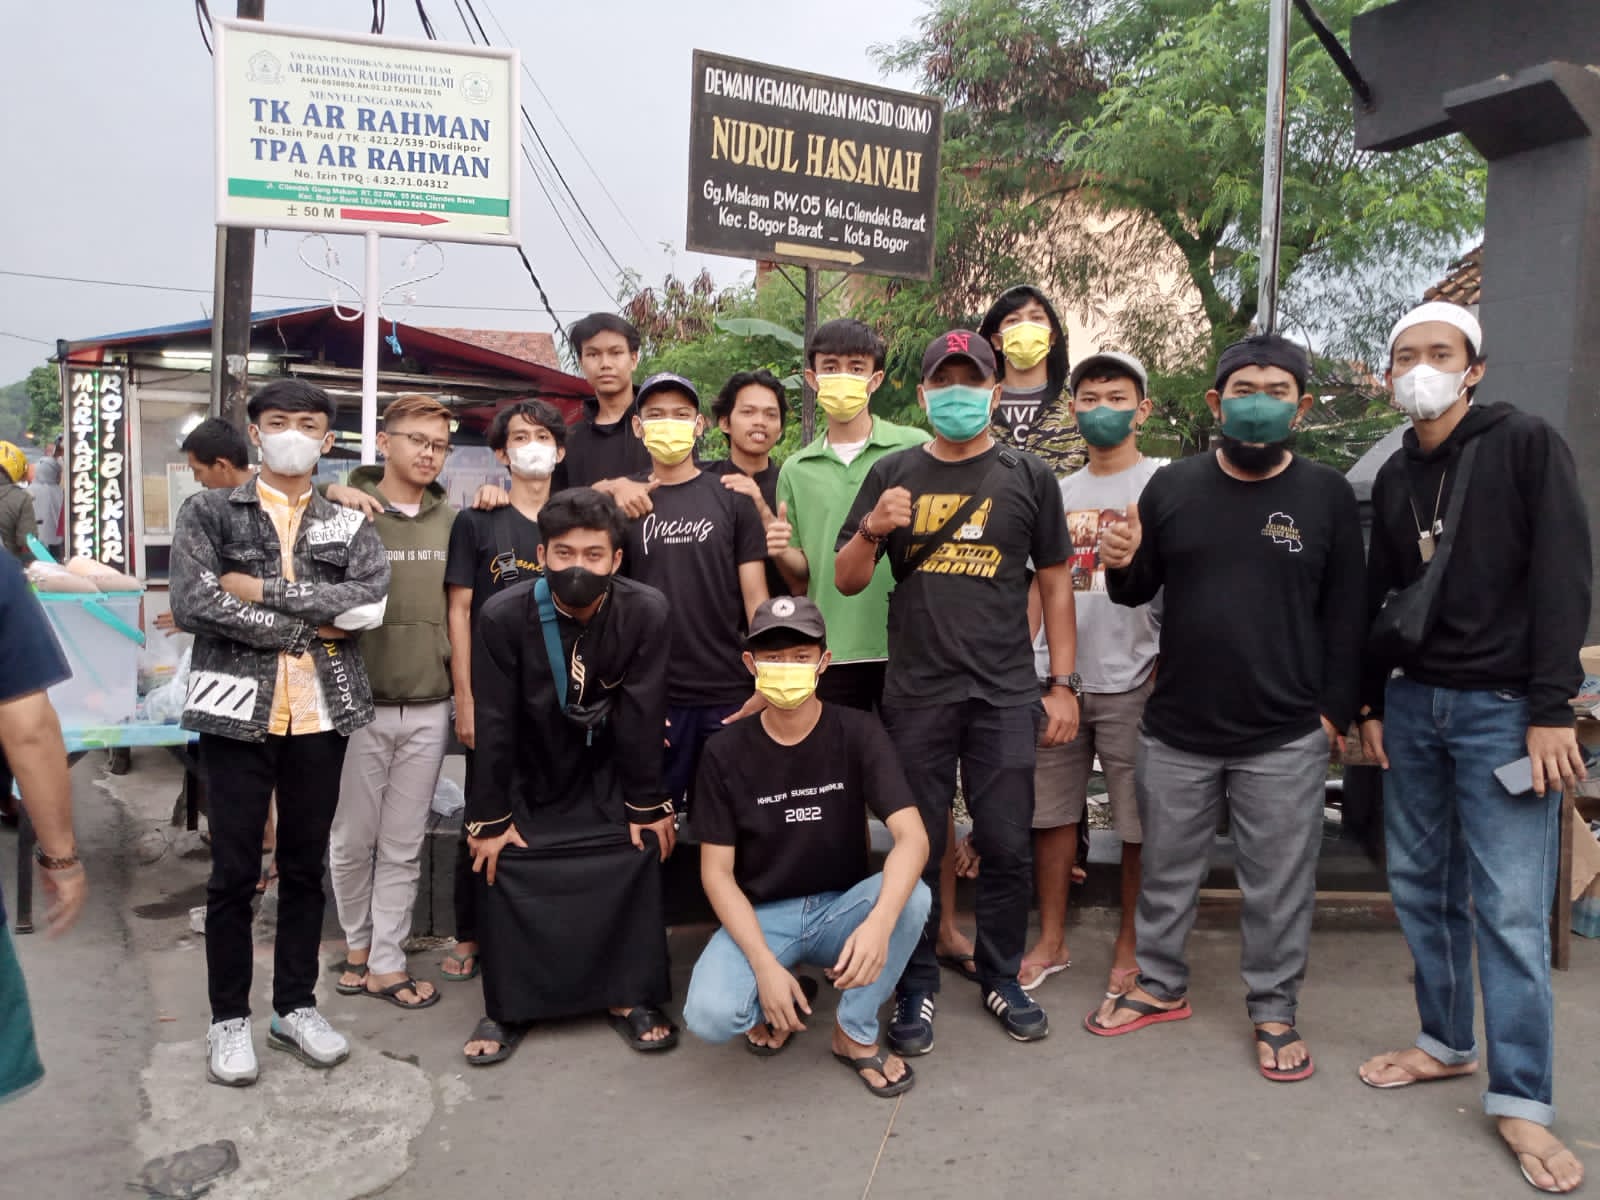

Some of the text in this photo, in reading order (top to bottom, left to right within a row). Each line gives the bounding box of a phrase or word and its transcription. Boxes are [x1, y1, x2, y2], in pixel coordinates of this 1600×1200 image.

[306, 63, 356, 79] RAHMAN
[704, 66, 932, 135] DEWAN KEMAKMURAN MASJID (DKM)
[249, 98, 490, 142] TK AR RAHMAN
[258, 125, 278, 137] No.
[282, 127, 303, 138] Izin
[306, 129, 334, 141] Paud
[250, 138, 490, 179] TPA AR RAHMAN
[711, 115, 922, 193] NURUL HASANAH
[294, 168, 313, 179] No.
[317, 171, 337, 180] Izin
[372, 175, 449, 189] 4.32.71.04312
[304, 206, 319, 218] 50
[323, 207, 335, 219] M
[891, 207, 927, 234] Barat
[748, 210, 787, 237] Bogor
[787, 215, 824, 240] Barat
[844, 223, 871, 247] Kota
[873, 228, 910, 254] Bogor
[71, 373, 94, 505] MARTABAK
[100, 374, 124, 564] ROTI BAKAR
[417, 549, 432, 561] NOT
[785, 805, 823, 823] 2022
